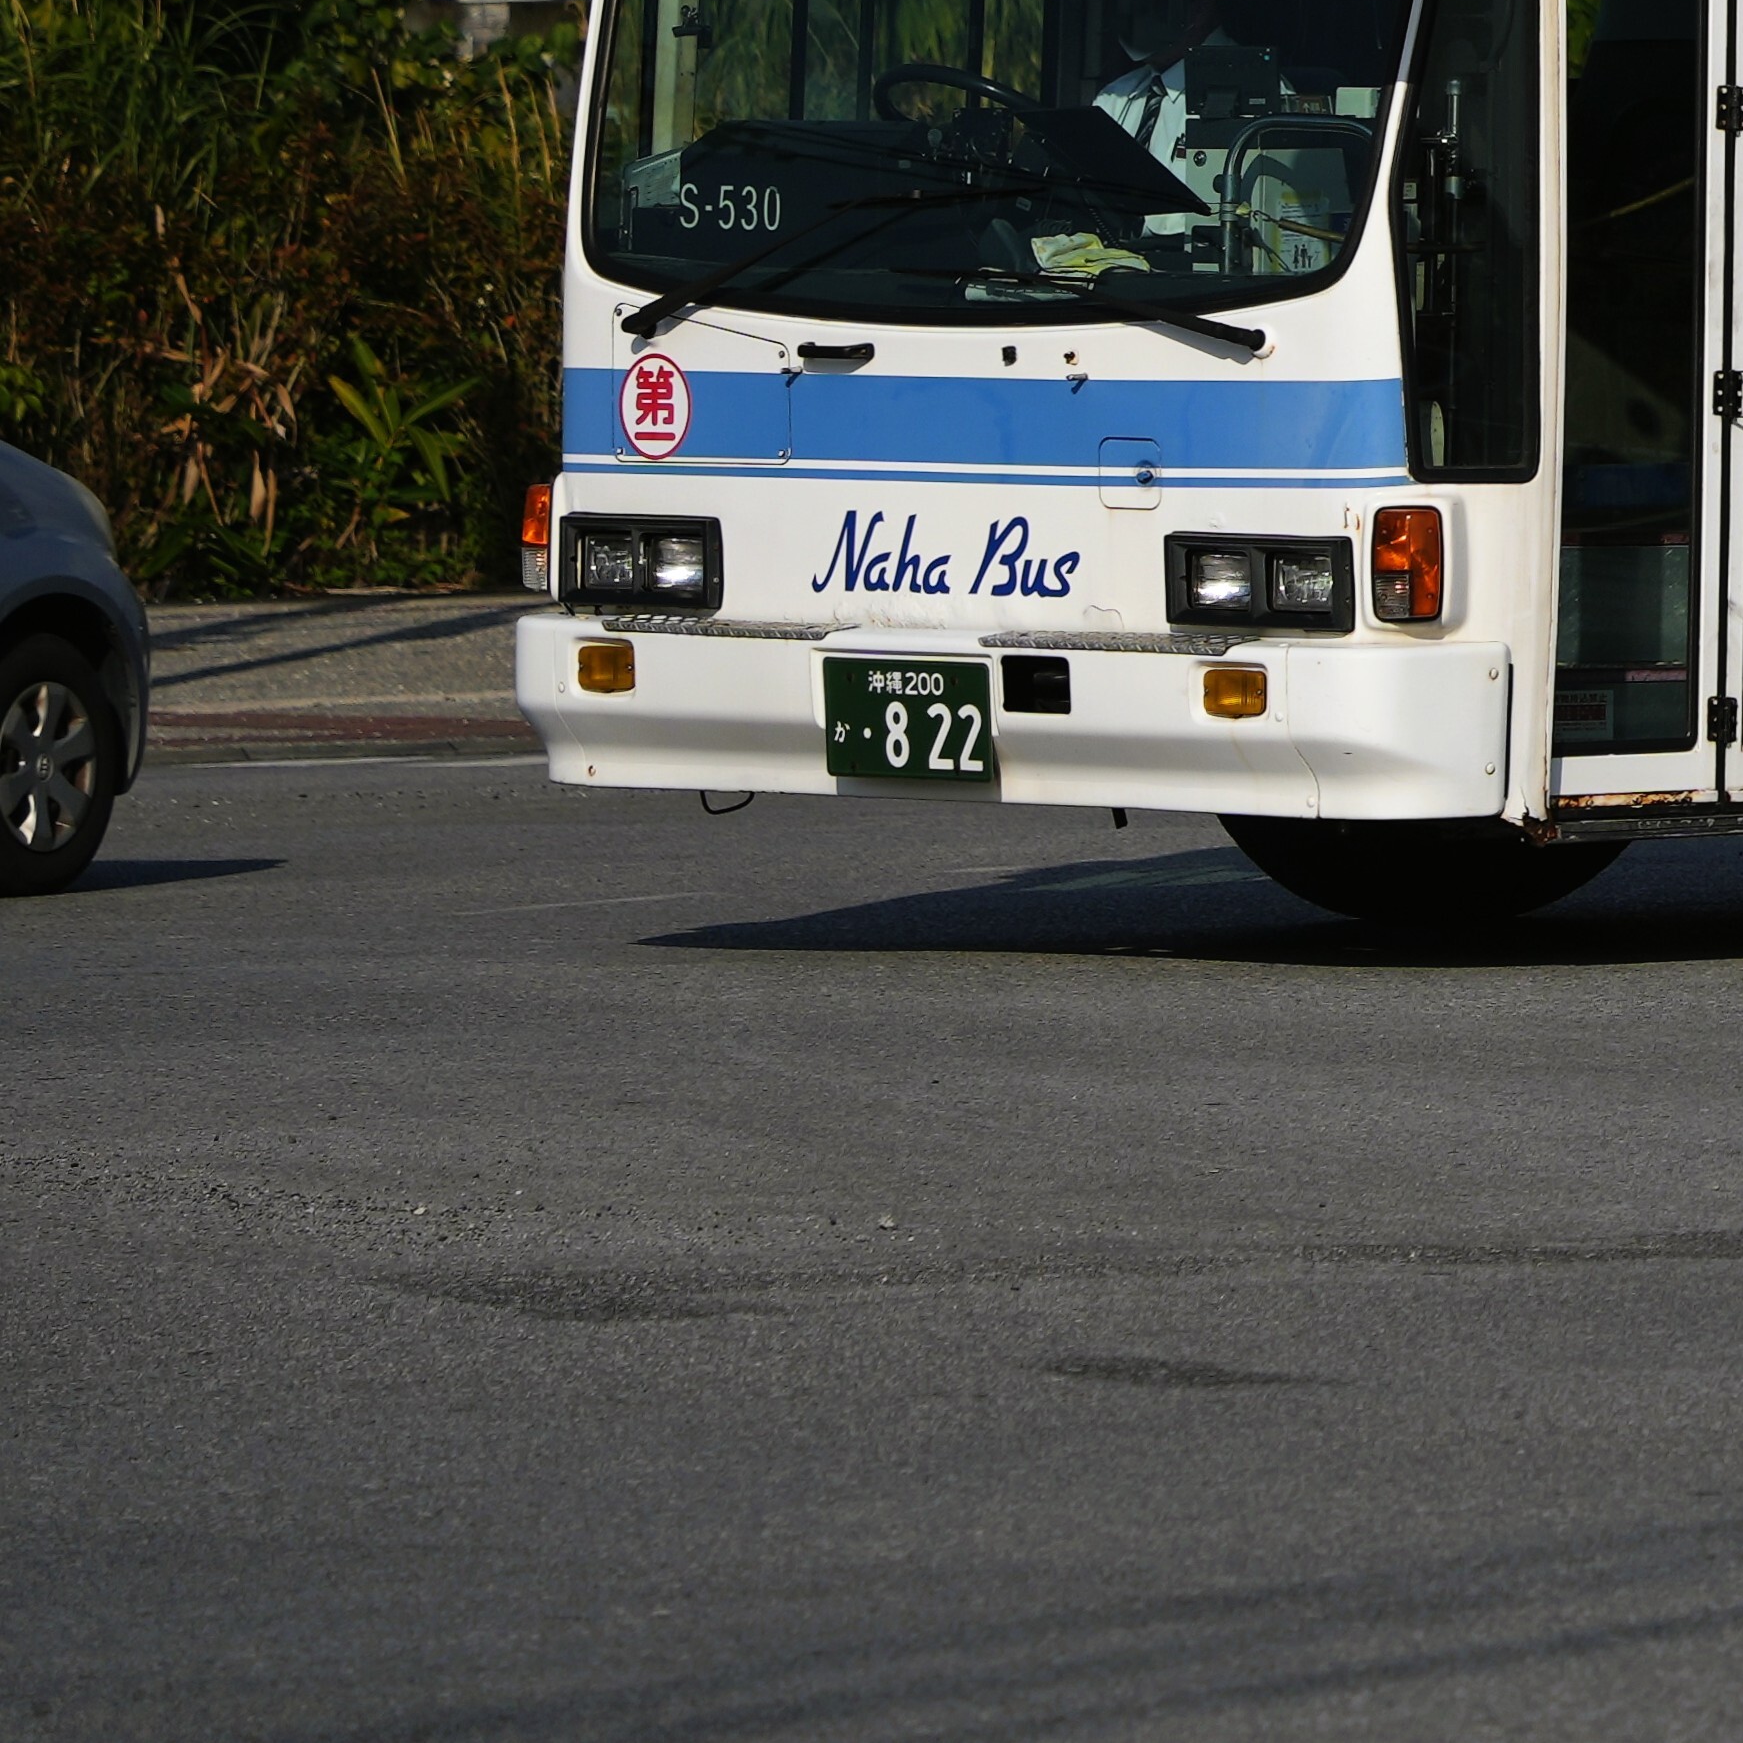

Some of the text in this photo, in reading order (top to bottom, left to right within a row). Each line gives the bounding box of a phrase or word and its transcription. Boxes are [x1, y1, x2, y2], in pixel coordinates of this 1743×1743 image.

[678, 183, 782, 232] S-530
[633, 365, 677, 442] 第一
[812, 508, 1081, 599] Naha Bus
[867, 670, 944, 696] 沖縄200
[834, 720, 851, 743] か
